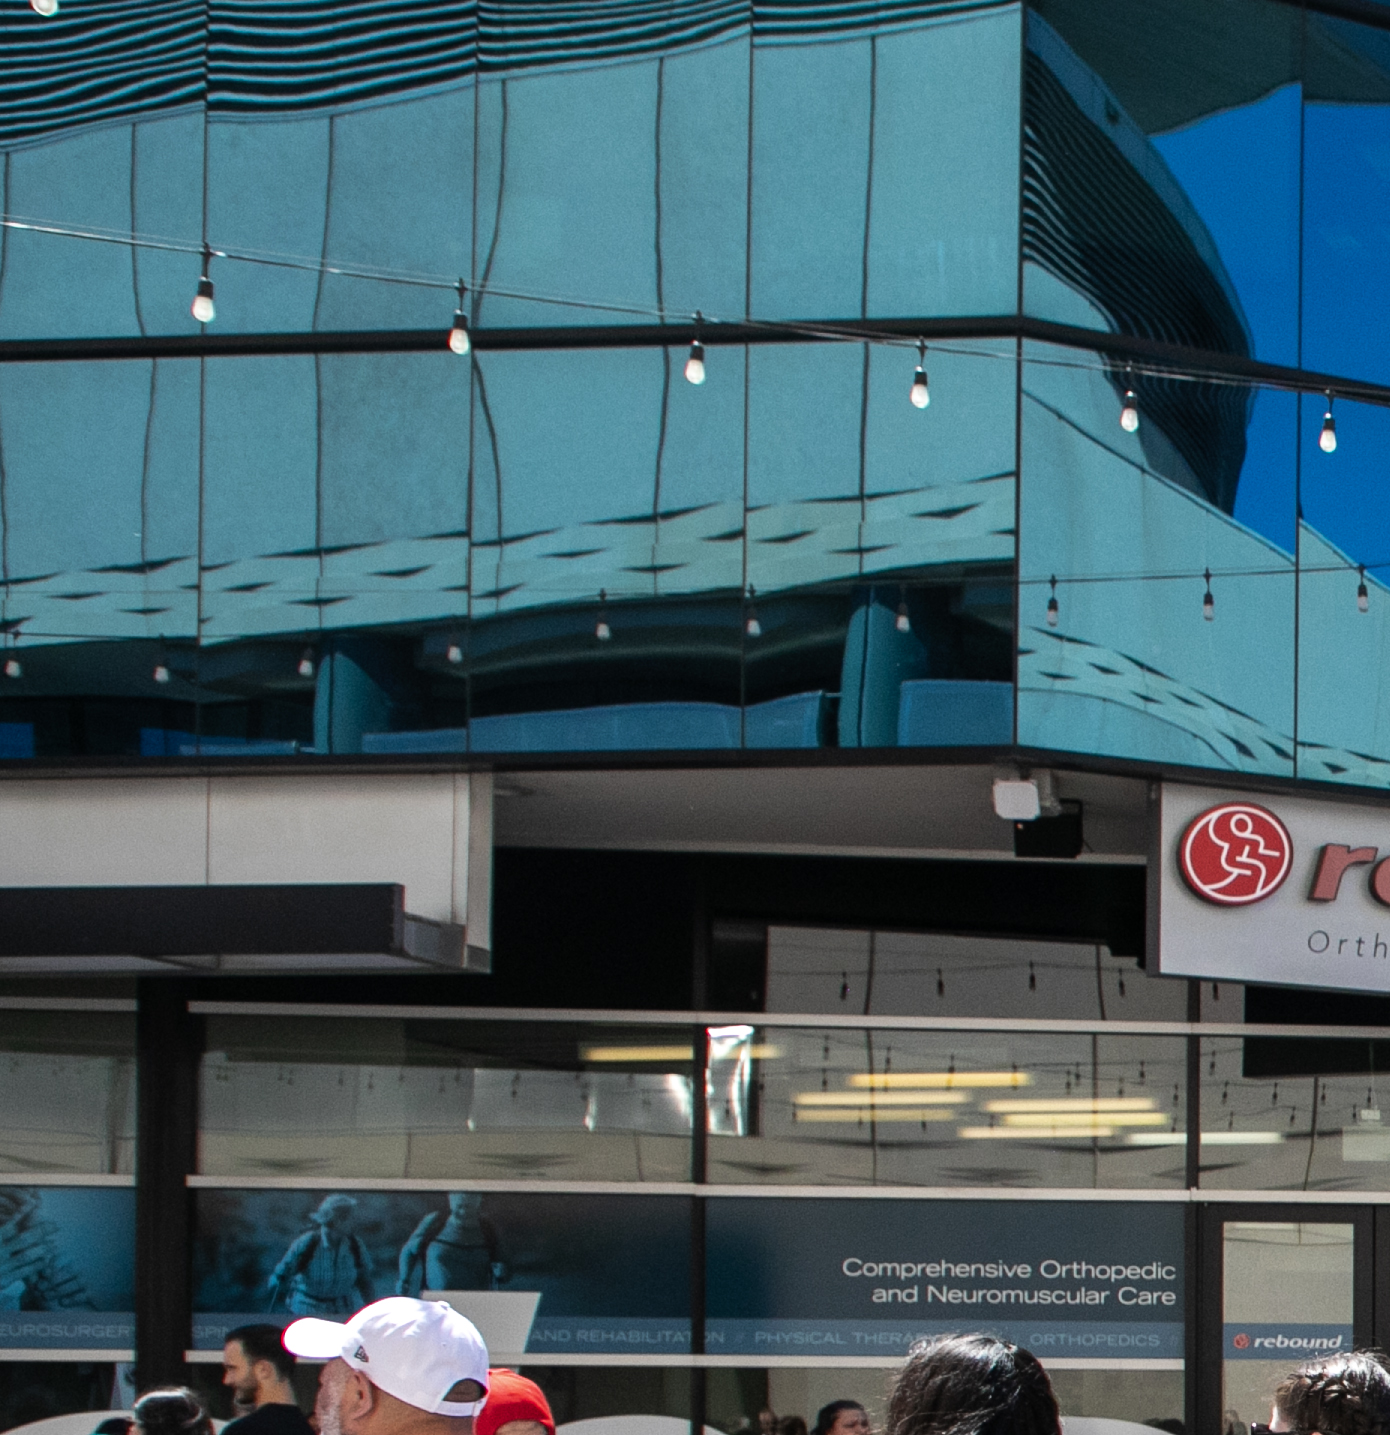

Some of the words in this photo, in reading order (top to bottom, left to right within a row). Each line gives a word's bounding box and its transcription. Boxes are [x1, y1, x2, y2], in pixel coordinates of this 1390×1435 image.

[842, 1257, 1032, 1280] Comprehensive
[1040, 1259, 1177, 1282] Orthopedic
[872, 1284, 918, 1304] and
[927, 1285, 1109, 1305] Neuromuscular
[1117, 1286, 1177, 1306] Care
[0, 1323, 130, 1339] EUROSURGER
[754, 1331, 846, 1345] PHYSICAL
[1029, 1333, 1161, 1347] ORTHOPEDICS
[1254, 1334, 1343, 1349] rebound
